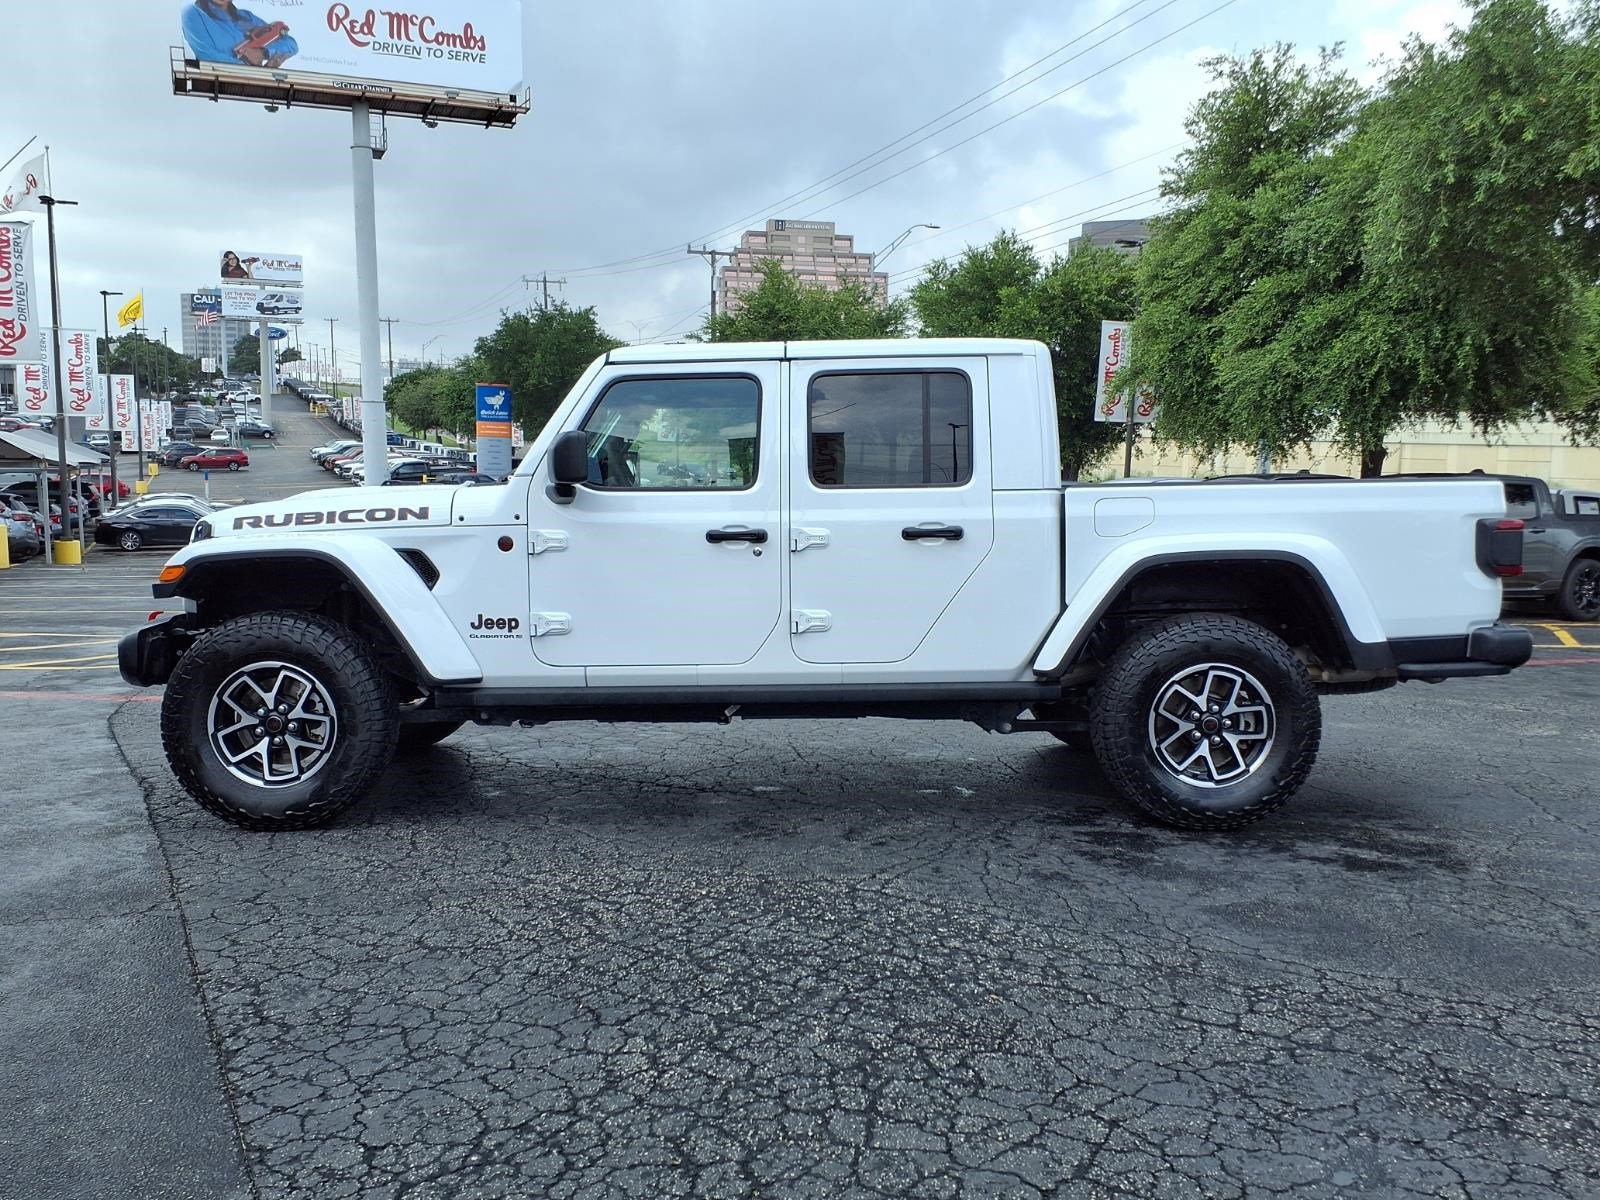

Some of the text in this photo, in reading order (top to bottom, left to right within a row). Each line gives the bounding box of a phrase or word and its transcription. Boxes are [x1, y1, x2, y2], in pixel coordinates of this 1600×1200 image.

[327, 3, 486, 51] Red McCombs
[372, 41, 486, 64] DRIVEN TO SERVE
[12, 228, 27, 322] DRIVEN TO SERVE
[68, 333, 92, 411] Red McCombs
[85, 355, 91, 367] TO
[41, 364, 49, 390] DRIVEN
[85, 367, 93, 391] DRIVEN
[25, 387, 47, 410] Red
[116, 378, 128, 411] McCombs
[117, 412, 131, 428] Red
[232, 506, 430, 530] RUBICON
[470, 614, 519, 633] Jeep
